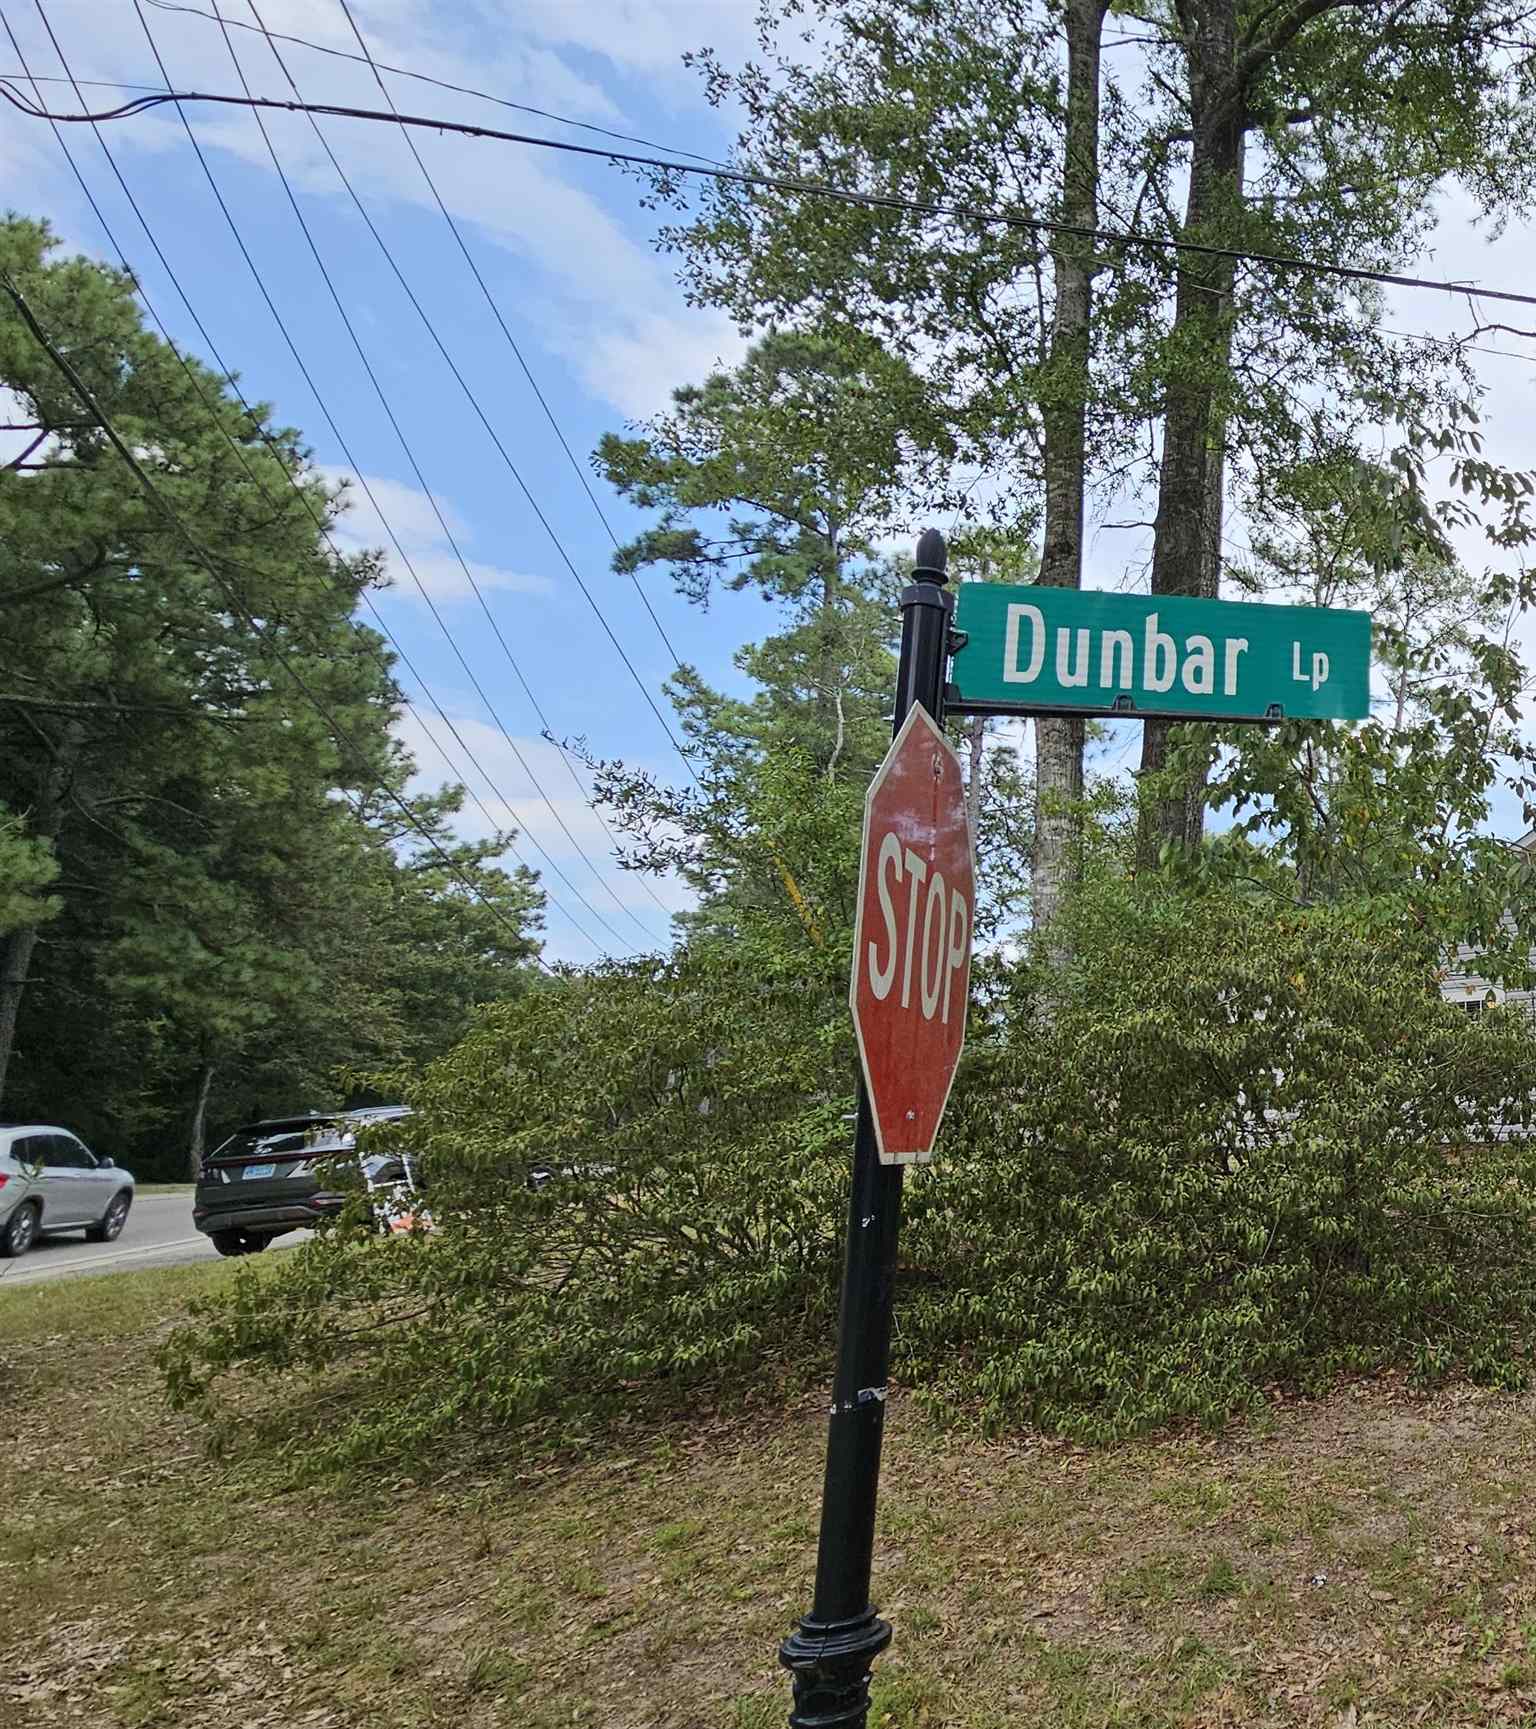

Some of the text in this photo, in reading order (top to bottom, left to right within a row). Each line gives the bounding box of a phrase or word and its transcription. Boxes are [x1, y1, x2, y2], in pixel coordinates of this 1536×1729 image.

[1002, 603, 1330, 695] Dunbar Lp
[868, 831, 967, 1024] STOP
